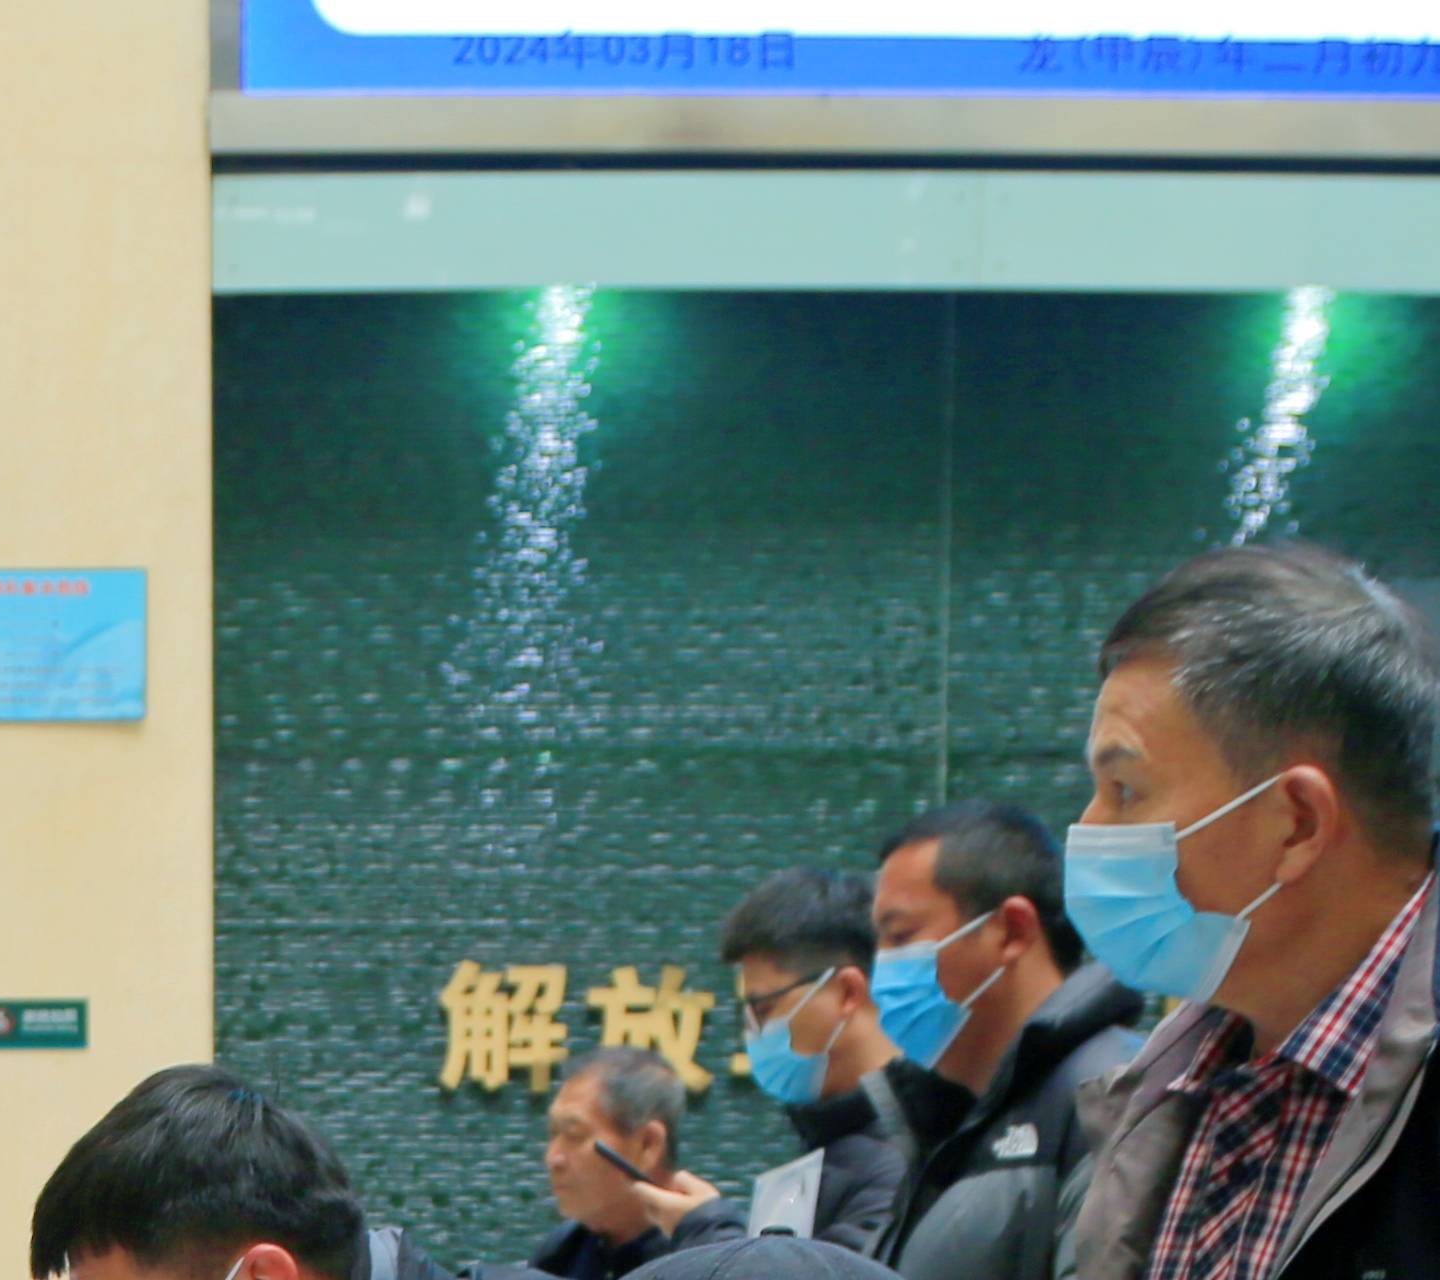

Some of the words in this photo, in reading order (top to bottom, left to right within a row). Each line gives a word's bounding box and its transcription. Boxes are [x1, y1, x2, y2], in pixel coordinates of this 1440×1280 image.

[453, 31, 795, 70] 2024年03月18日
[438, 958, 752, 1094] 解放
